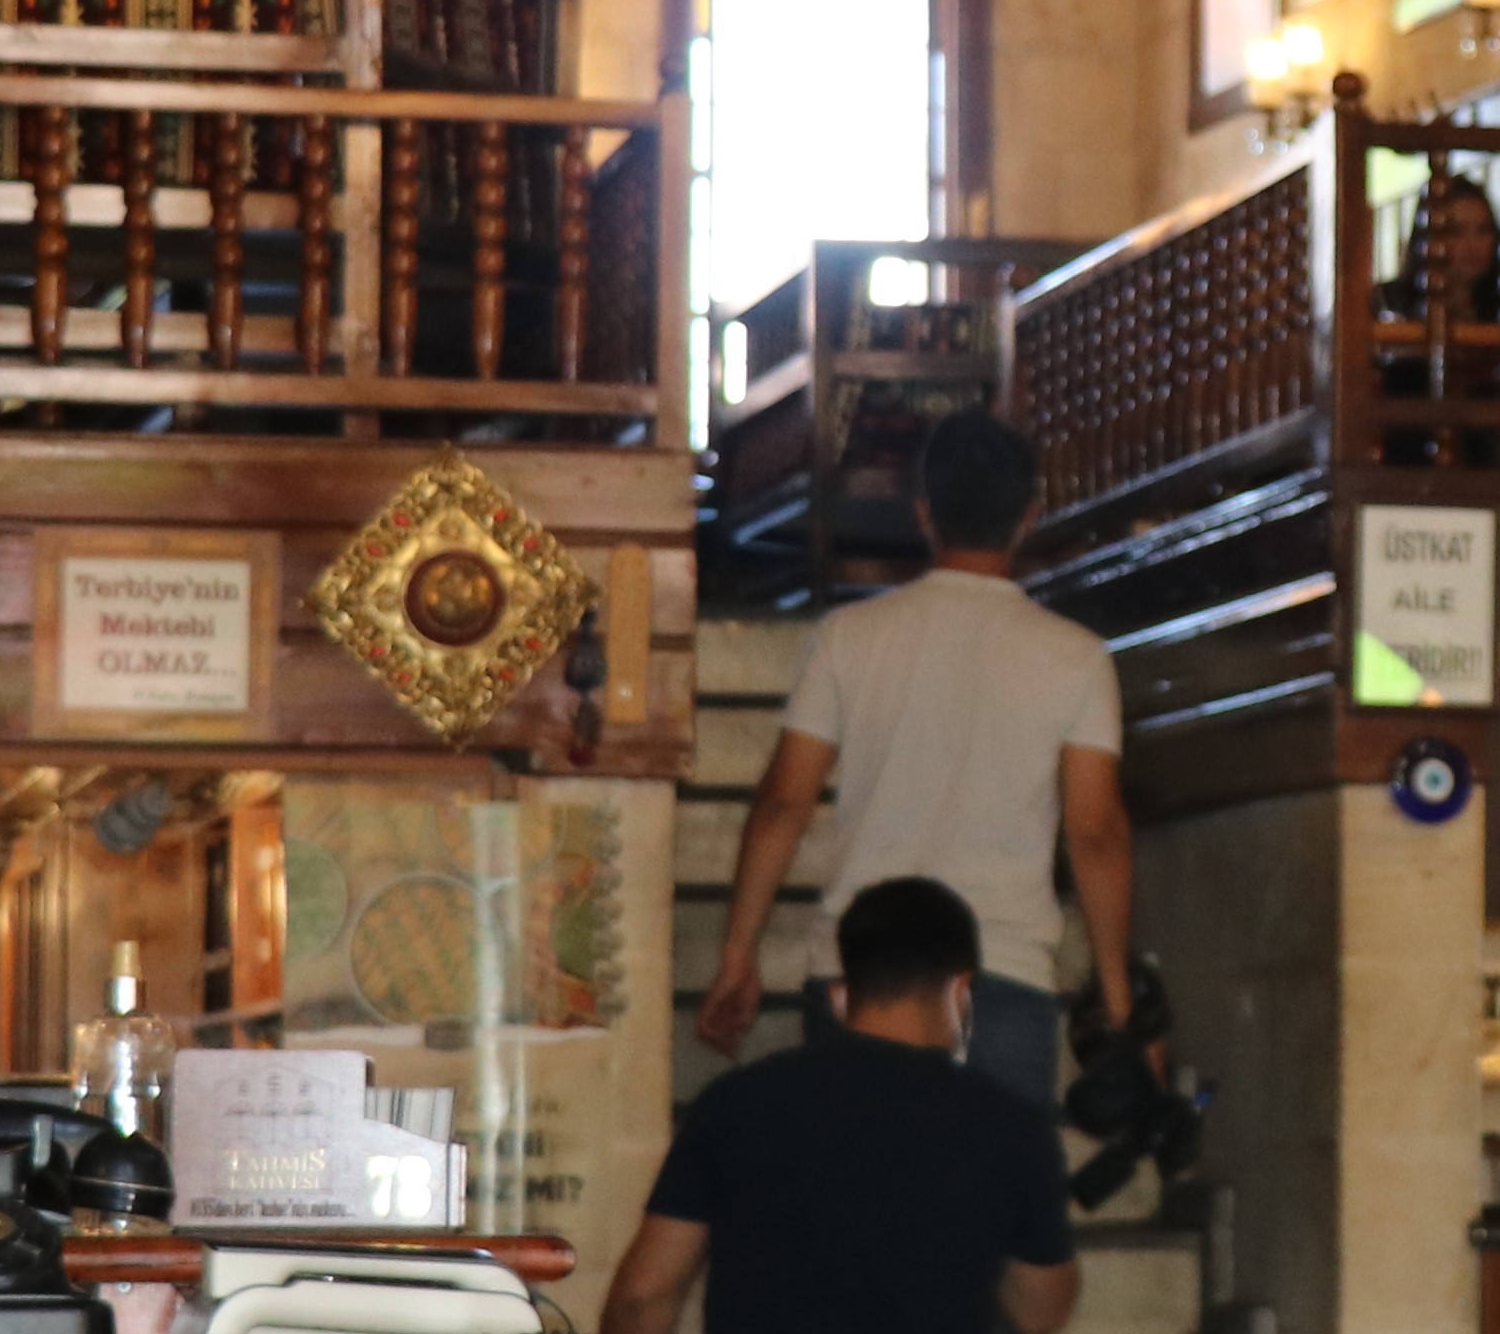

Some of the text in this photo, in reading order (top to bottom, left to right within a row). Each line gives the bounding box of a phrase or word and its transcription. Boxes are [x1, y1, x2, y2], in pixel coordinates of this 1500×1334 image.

[1384, 523, 1474, 563] ÜSTKAT
[74, 573, 239, 605] Terbiye'nin
[1392, 581, 1456, 612] AİLE
[100, 611, 216, 638] Mektebi
